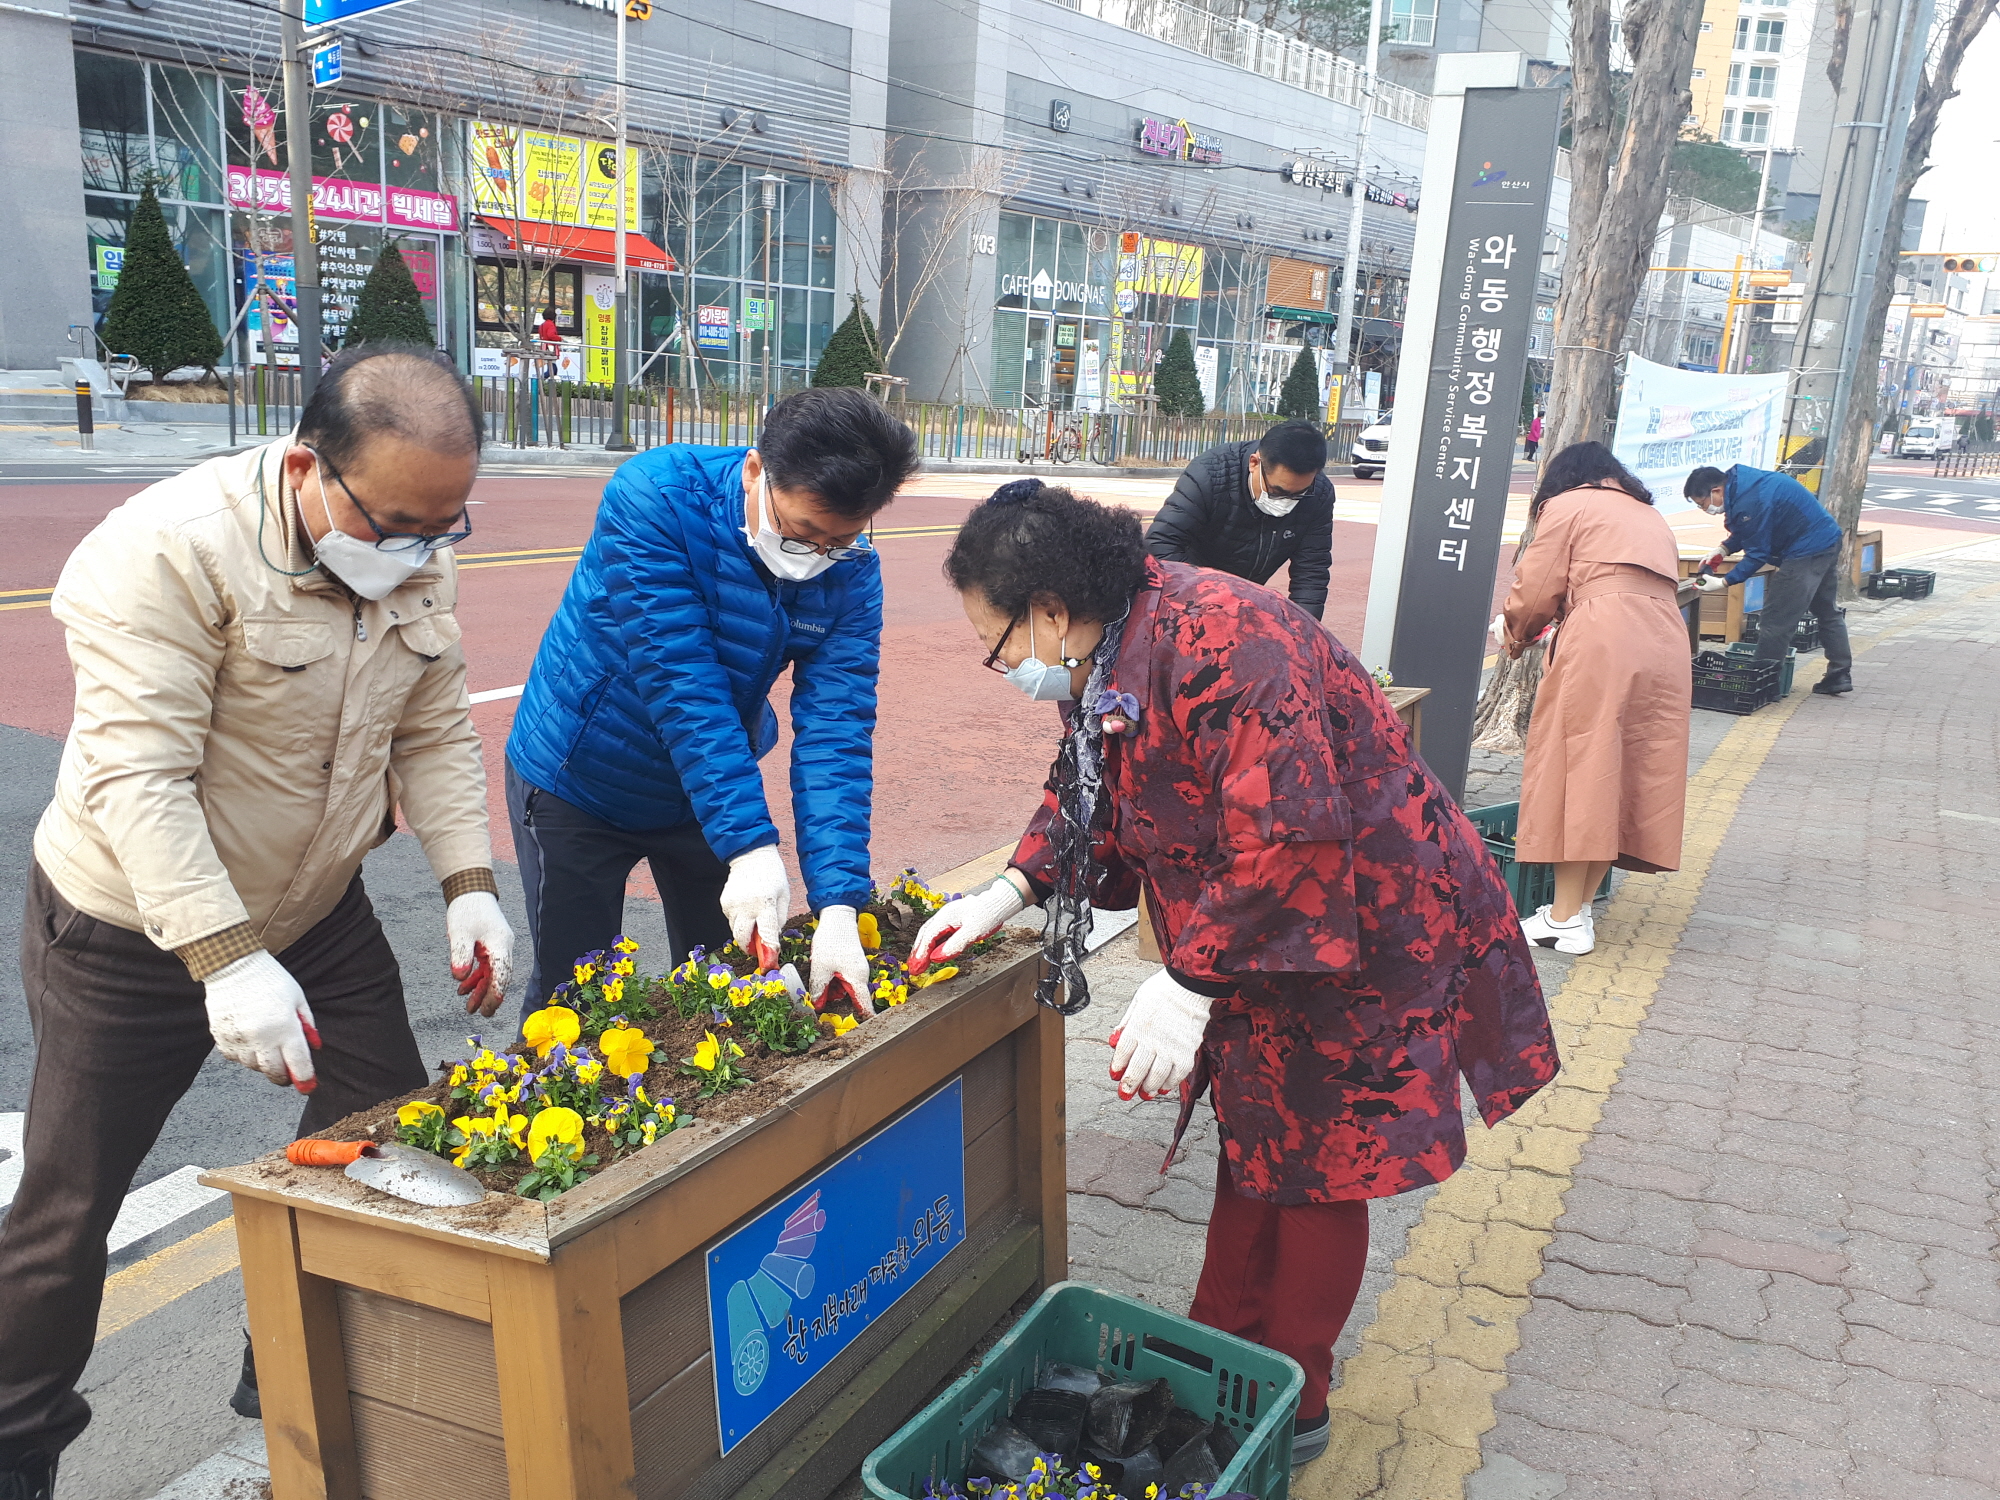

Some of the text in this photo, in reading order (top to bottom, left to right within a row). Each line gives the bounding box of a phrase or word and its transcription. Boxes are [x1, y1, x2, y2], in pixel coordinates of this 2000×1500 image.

[1501, 181, 1530, 189] 안산시
[311, 183, 382, 216] 24시간
[393, 194, 452, 226] 빅세일
[318, 229, 347, 243] #핫템
[319, 245, 357, 260] #인싸템
[320, 276, 366, 290] #옛날과자
[1001, 274, 1107, 305] CAFE DONGNAE
[322, 308, 353, 321] #무인
[699, 308, 728, 325] 상가문의
[1536, 306, 1553, 322] GS25
[1435, 238, 1481, 480] Wa-dong Community Service Center
[789, 618, 826, 633] olumbia
[783, 1315, 808, 1364] 한
[868, 1236, 910, 1285] 따뜻한
[911, 1194, 954, 1258] 와동
